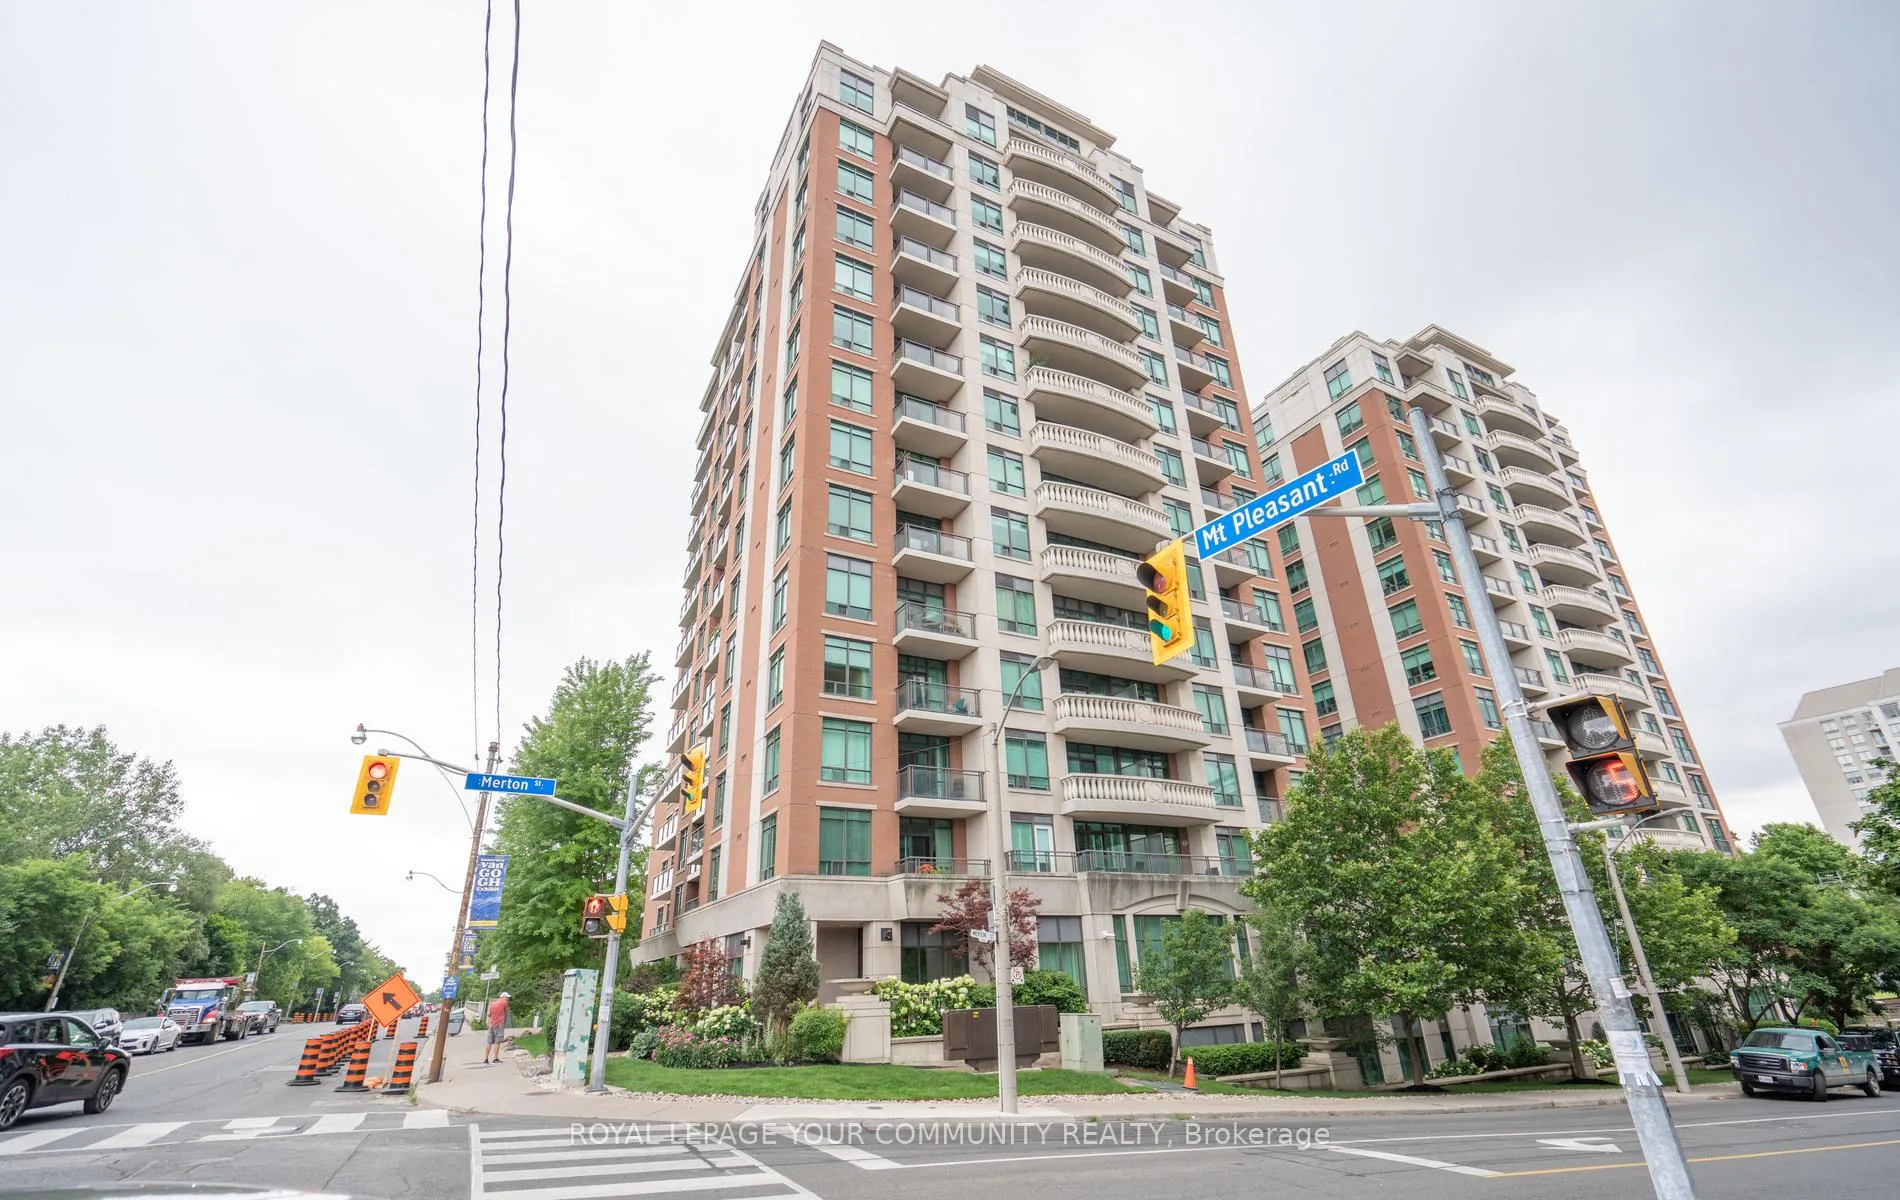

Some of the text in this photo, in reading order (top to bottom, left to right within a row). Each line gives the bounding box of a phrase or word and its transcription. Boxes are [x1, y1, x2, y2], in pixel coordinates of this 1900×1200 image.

[1202, 459, 1349, 550] Mt Pleasant Rd
[481, 776, 528, 790] Merton
[479, 868, 502, 878] GO
[477, 877, 501, 887] GH
